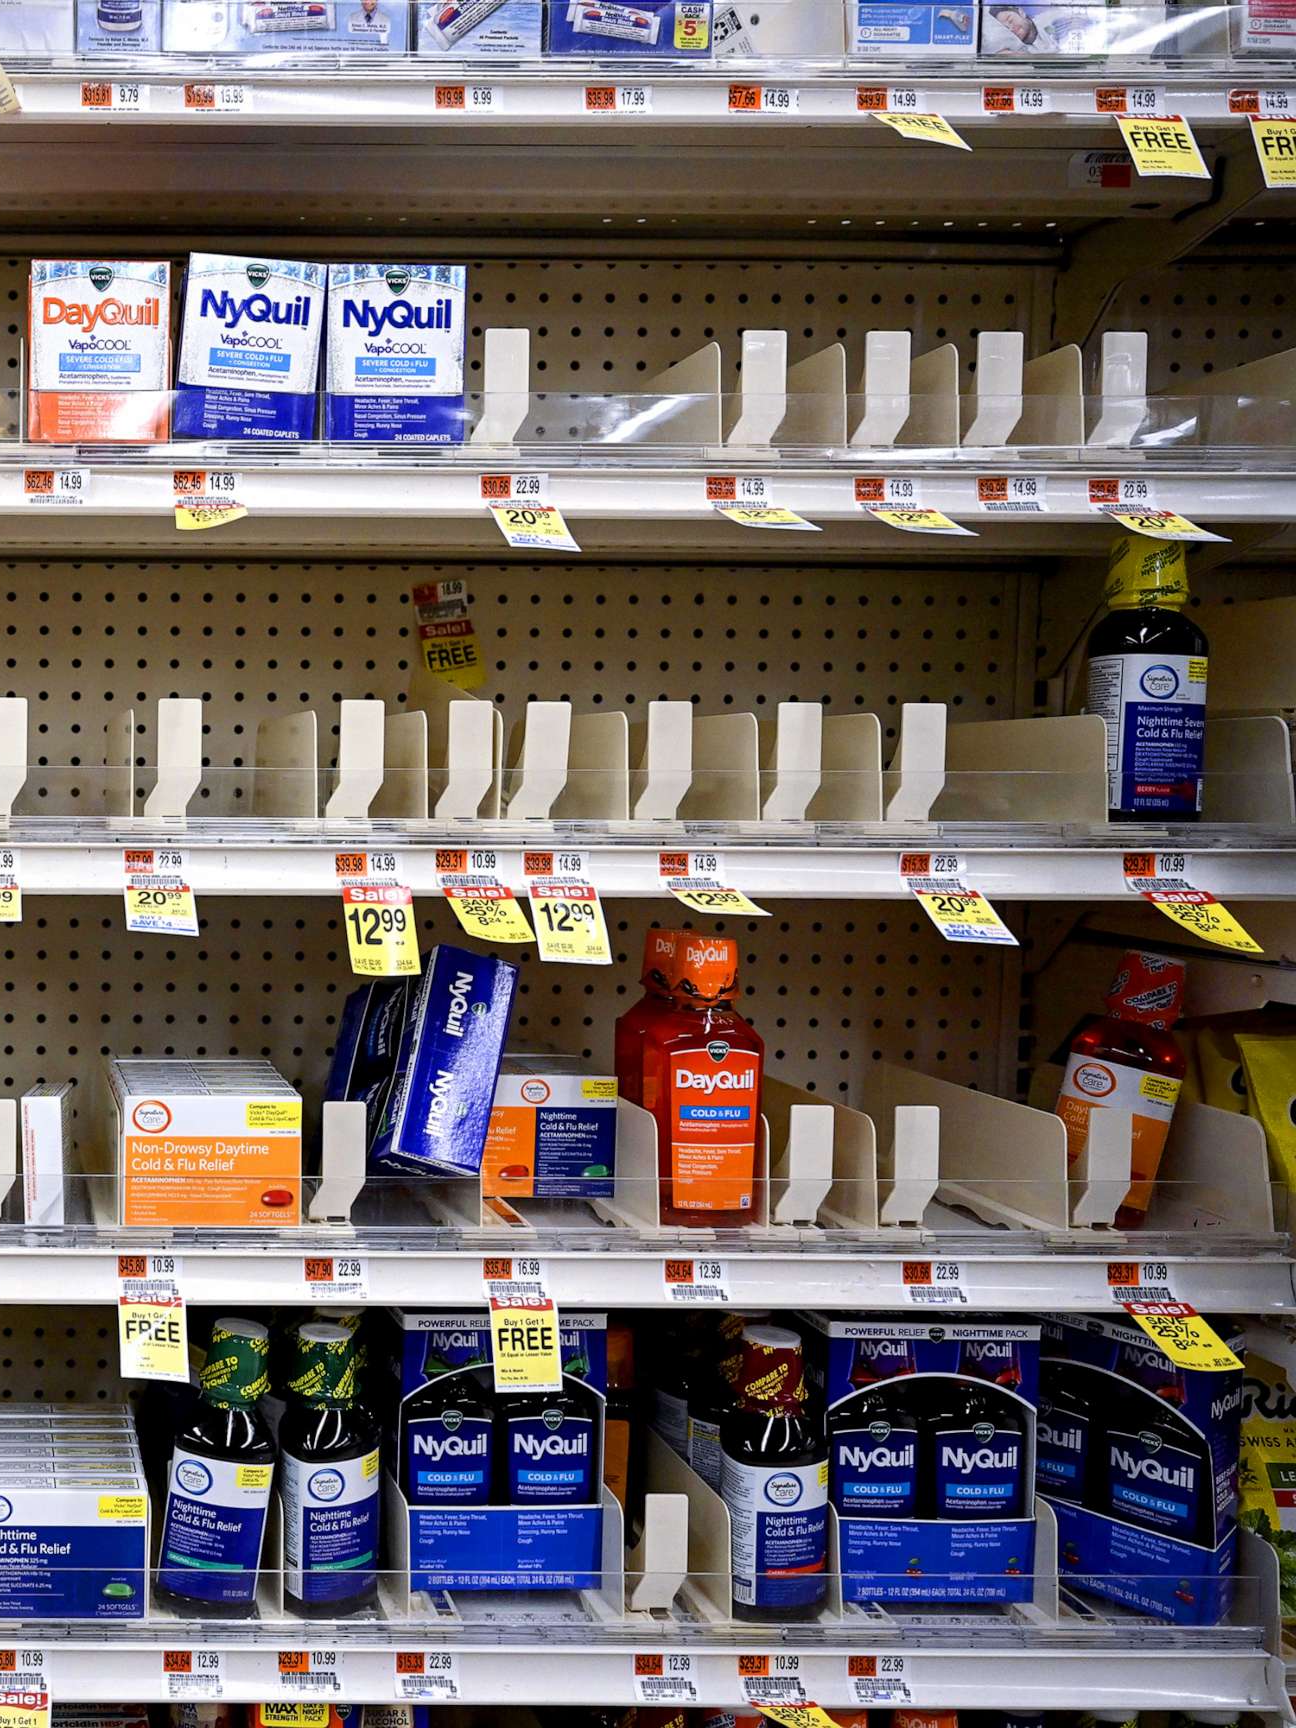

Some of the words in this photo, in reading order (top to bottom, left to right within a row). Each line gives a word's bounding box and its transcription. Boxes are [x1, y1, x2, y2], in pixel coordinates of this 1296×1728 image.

[681, 6, 705, 14] CASH
[120, 89, 138, 102] 9.79
[621, 91, 644, 105] 17.99
[765, 91, 790, 108] 14.99
[1021, 93, 1043, 106] 14.99
[1130, 131, 1191, 149] FREE
[43, 297, 159, 333] DayQuil
[201, 289, 310, 329] NyQuil
[343, 300, 451, 336] NyQuil
[362, 360, 388, 368] SEVERE
[390, 360, 409, 368] COLD
[516, 480, 540, 494] 22.99
[427, 647, 477, 668] FREE
[1137, 717, 1181, 728] Nighttime
[1137, 727, 1159, 738] Cold
[1170, 729, 1185, 739] Flu
[1154, 893, 1208, 903] Sale!
[676, 1069, 754, 1095] DayQuil
[540, 1111, 577, 1121] Nighttime
[540, 1121, 559, 1131] Cold
[559, 1122, 566, 1130] &
[568, 1121, 580, 1130] Flu
[580, 1122, 599, 1131] Relief
[132, 1142, 212, 1157] Non-Drowsy
[216, 1142, 269, 1157] Daytime
[132, 1158, 161, 1171] Cold
[164, 1159, 174, 1171] &
[178, 1158, 196, 1171] Flu
[199, 1158, 235, 1171] Relief
[152, 1258, 174, 1273] 10.99
[1143, 1265, 1167, 1280] 10.99
[497, 1327, 554, 1351] FREE
[845, 1327, 896, 1337] POWERFUL
[898, 1328, 926, 1337] RELIEF
[953, 1328, 1003, 1338] NIGHTTIME
[1006, 1329, 1028, 1338] PACK
[414, 1433, 487, 1460] NyQuil
[514, 1433, 587, 1460] NyQuil
[839, 1445, 914, 1472] NyQuil
[942, 1446, 1017, 1473] NyQuil
[1111, 1447, 1195, 1492] NyQuil
[854, 1485, 876, 1494] COLD
[886, 1485, 902, 1494] FLU
[7, 1543, 17, 1554] &
[20, 1542, 37, 1554] Flu
[39, 1543, 71, 1555] Relief
[21, 1651, 43, 1666] 10.99
[775, 1655, 799, 1670] 10.99
